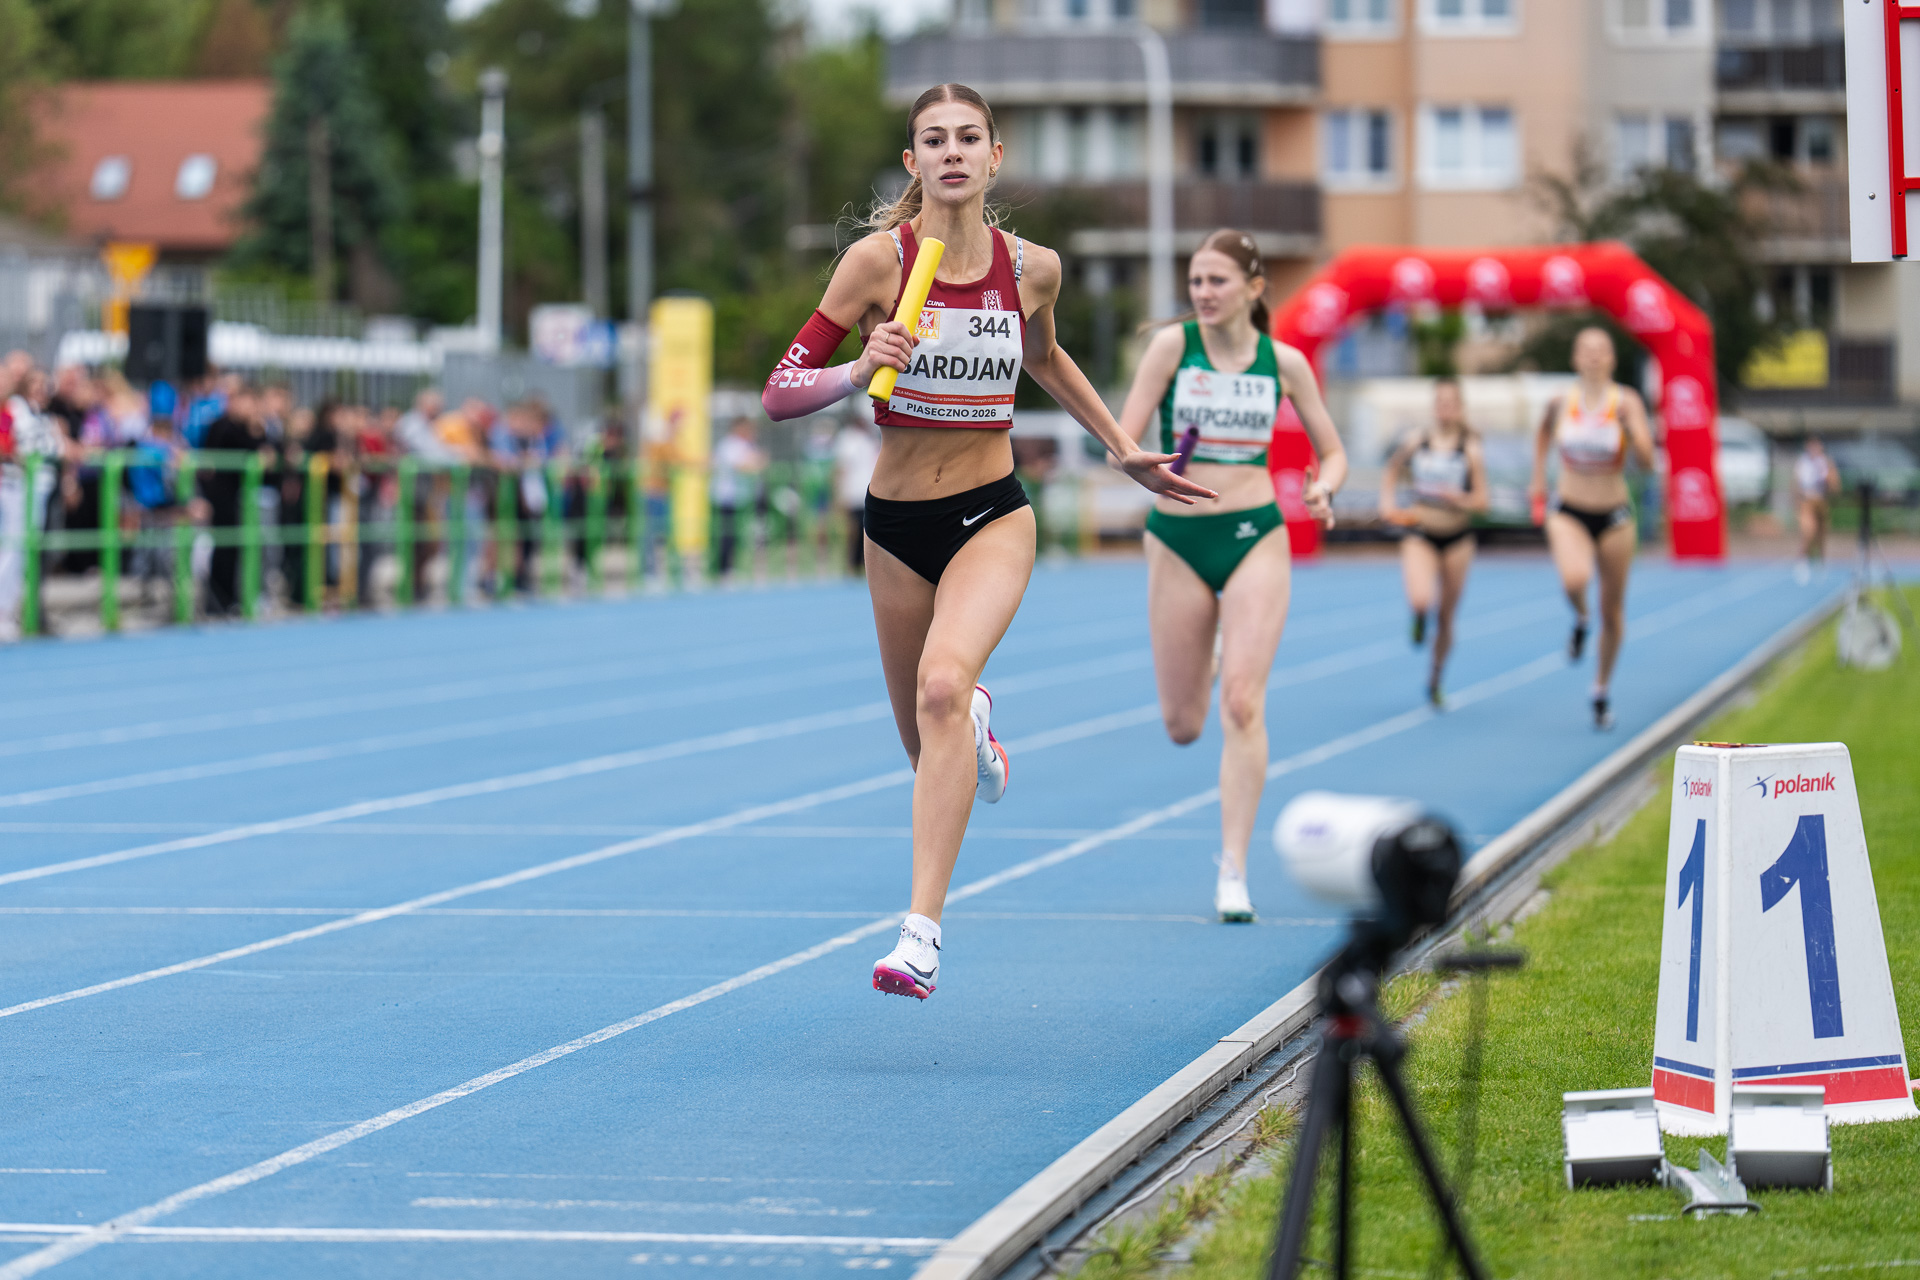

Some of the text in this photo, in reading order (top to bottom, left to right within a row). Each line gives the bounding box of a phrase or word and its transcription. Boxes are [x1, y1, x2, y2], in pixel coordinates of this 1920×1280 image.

[968, 316, 1011, 339] 344
[1233, 380, 1266, 397] 119
[906, 402, 997, 418] PIASECZNO 2026
[1774, 772, 1836, 799] polanik
[1678, 818, 1706, 1043] 1
[1760, 814, 1844, 1039] 1
